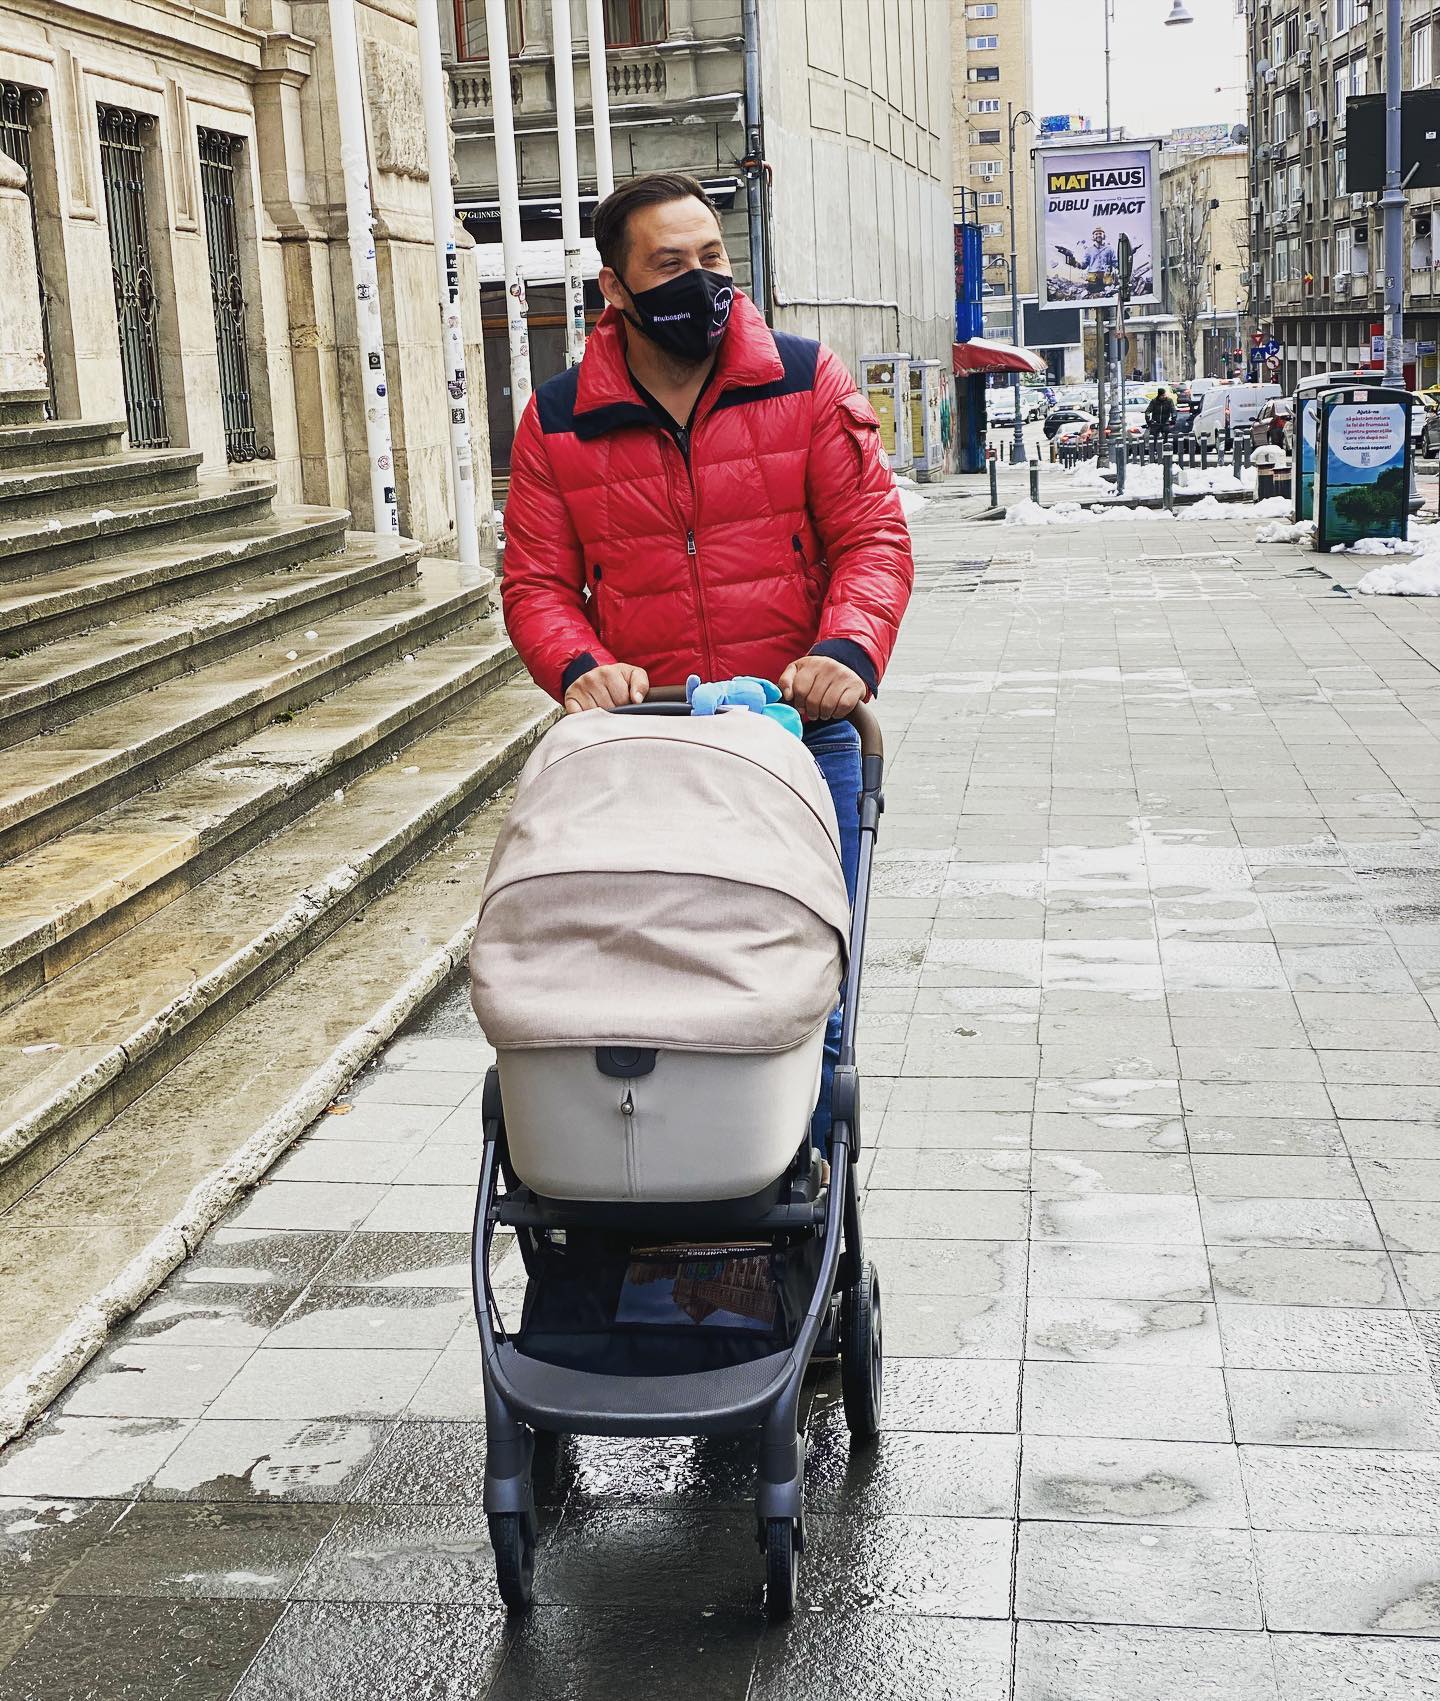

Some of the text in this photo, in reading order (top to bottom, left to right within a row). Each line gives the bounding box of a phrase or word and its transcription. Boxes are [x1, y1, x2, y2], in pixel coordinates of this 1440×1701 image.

[1050, 171, 1142, 191] MATHAUS
[1048, 199, 1146, 217] DUBLU IMPACT
